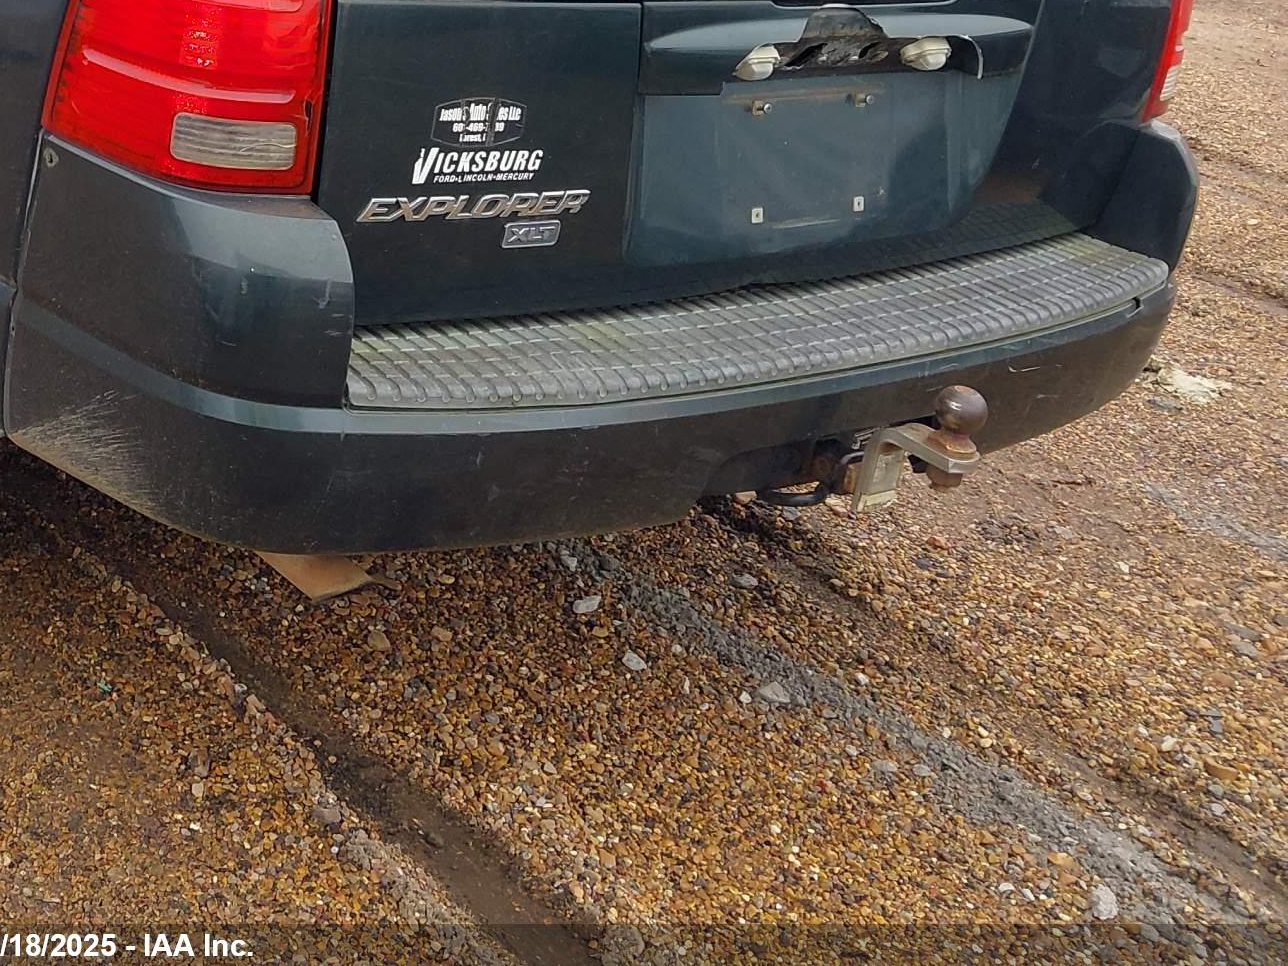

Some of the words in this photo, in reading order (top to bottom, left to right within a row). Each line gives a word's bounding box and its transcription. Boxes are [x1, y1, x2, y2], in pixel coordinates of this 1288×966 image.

[412, 147, 544, 184] VICKSBURG
[356, 189, 592, 223] EXPLORER
[507, 226, 556, 243] XLT
